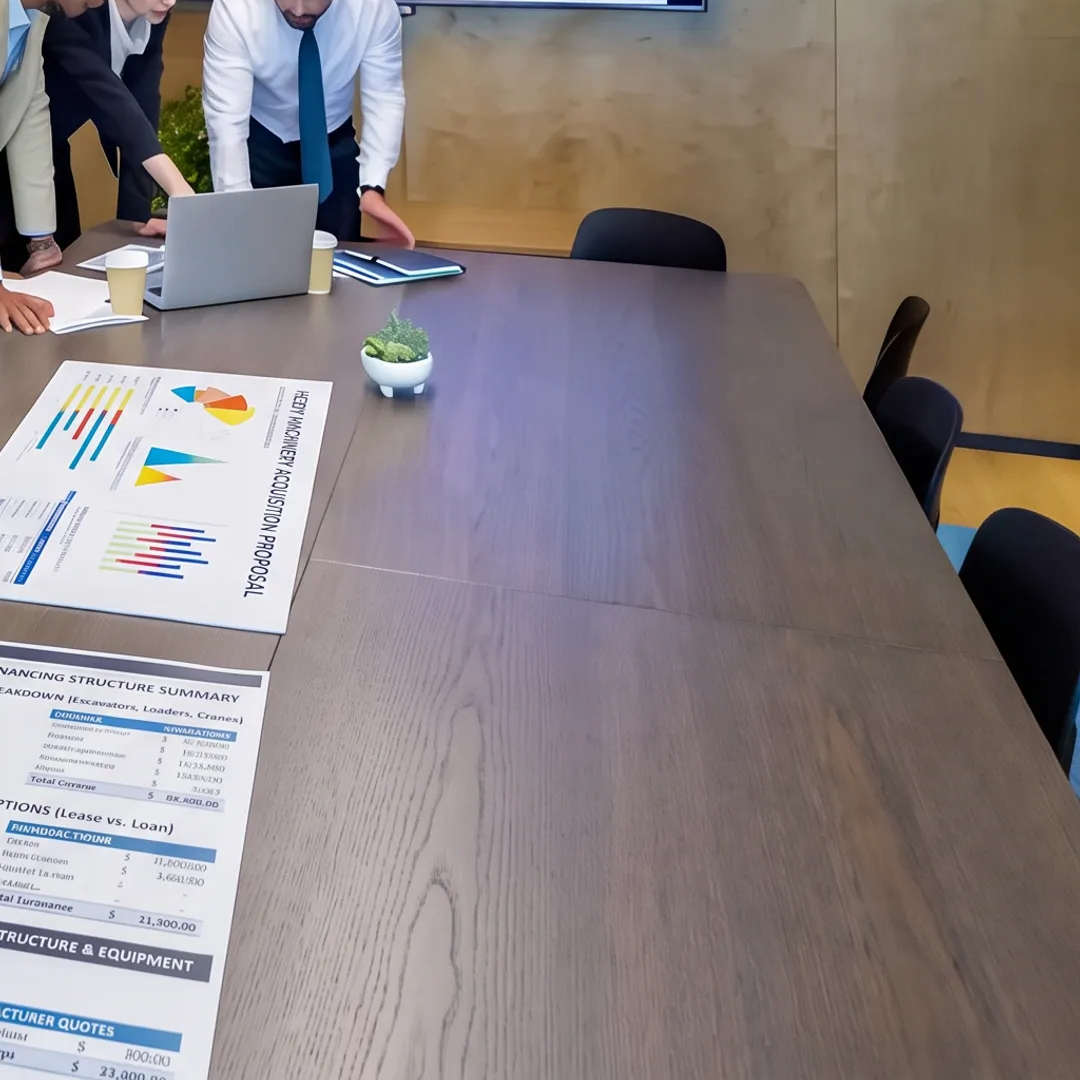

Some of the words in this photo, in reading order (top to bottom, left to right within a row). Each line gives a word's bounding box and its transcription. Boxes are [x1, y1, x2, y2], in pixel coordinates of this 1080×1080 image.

[260, 468, 292, 533] ACQUISITION
[243, 534, 276, 598] PROPOSAL
[68, 674, 155, 694] STRUCTURE
[158, 685, 241, 704] SUMMARY
[196, 711, 244, 725] Cranes)
[30, 775, 56, 786] Total
[54, 806, 103, 824] (Lease
[107, 817, 127, 827] vs.
[131, 818, 175, 836] Loan)
[81, 943, 94, 956] &
[98, 946, 194, 973] EQUIPMENT
[57, 1017, 116, 1038] QUOTES
